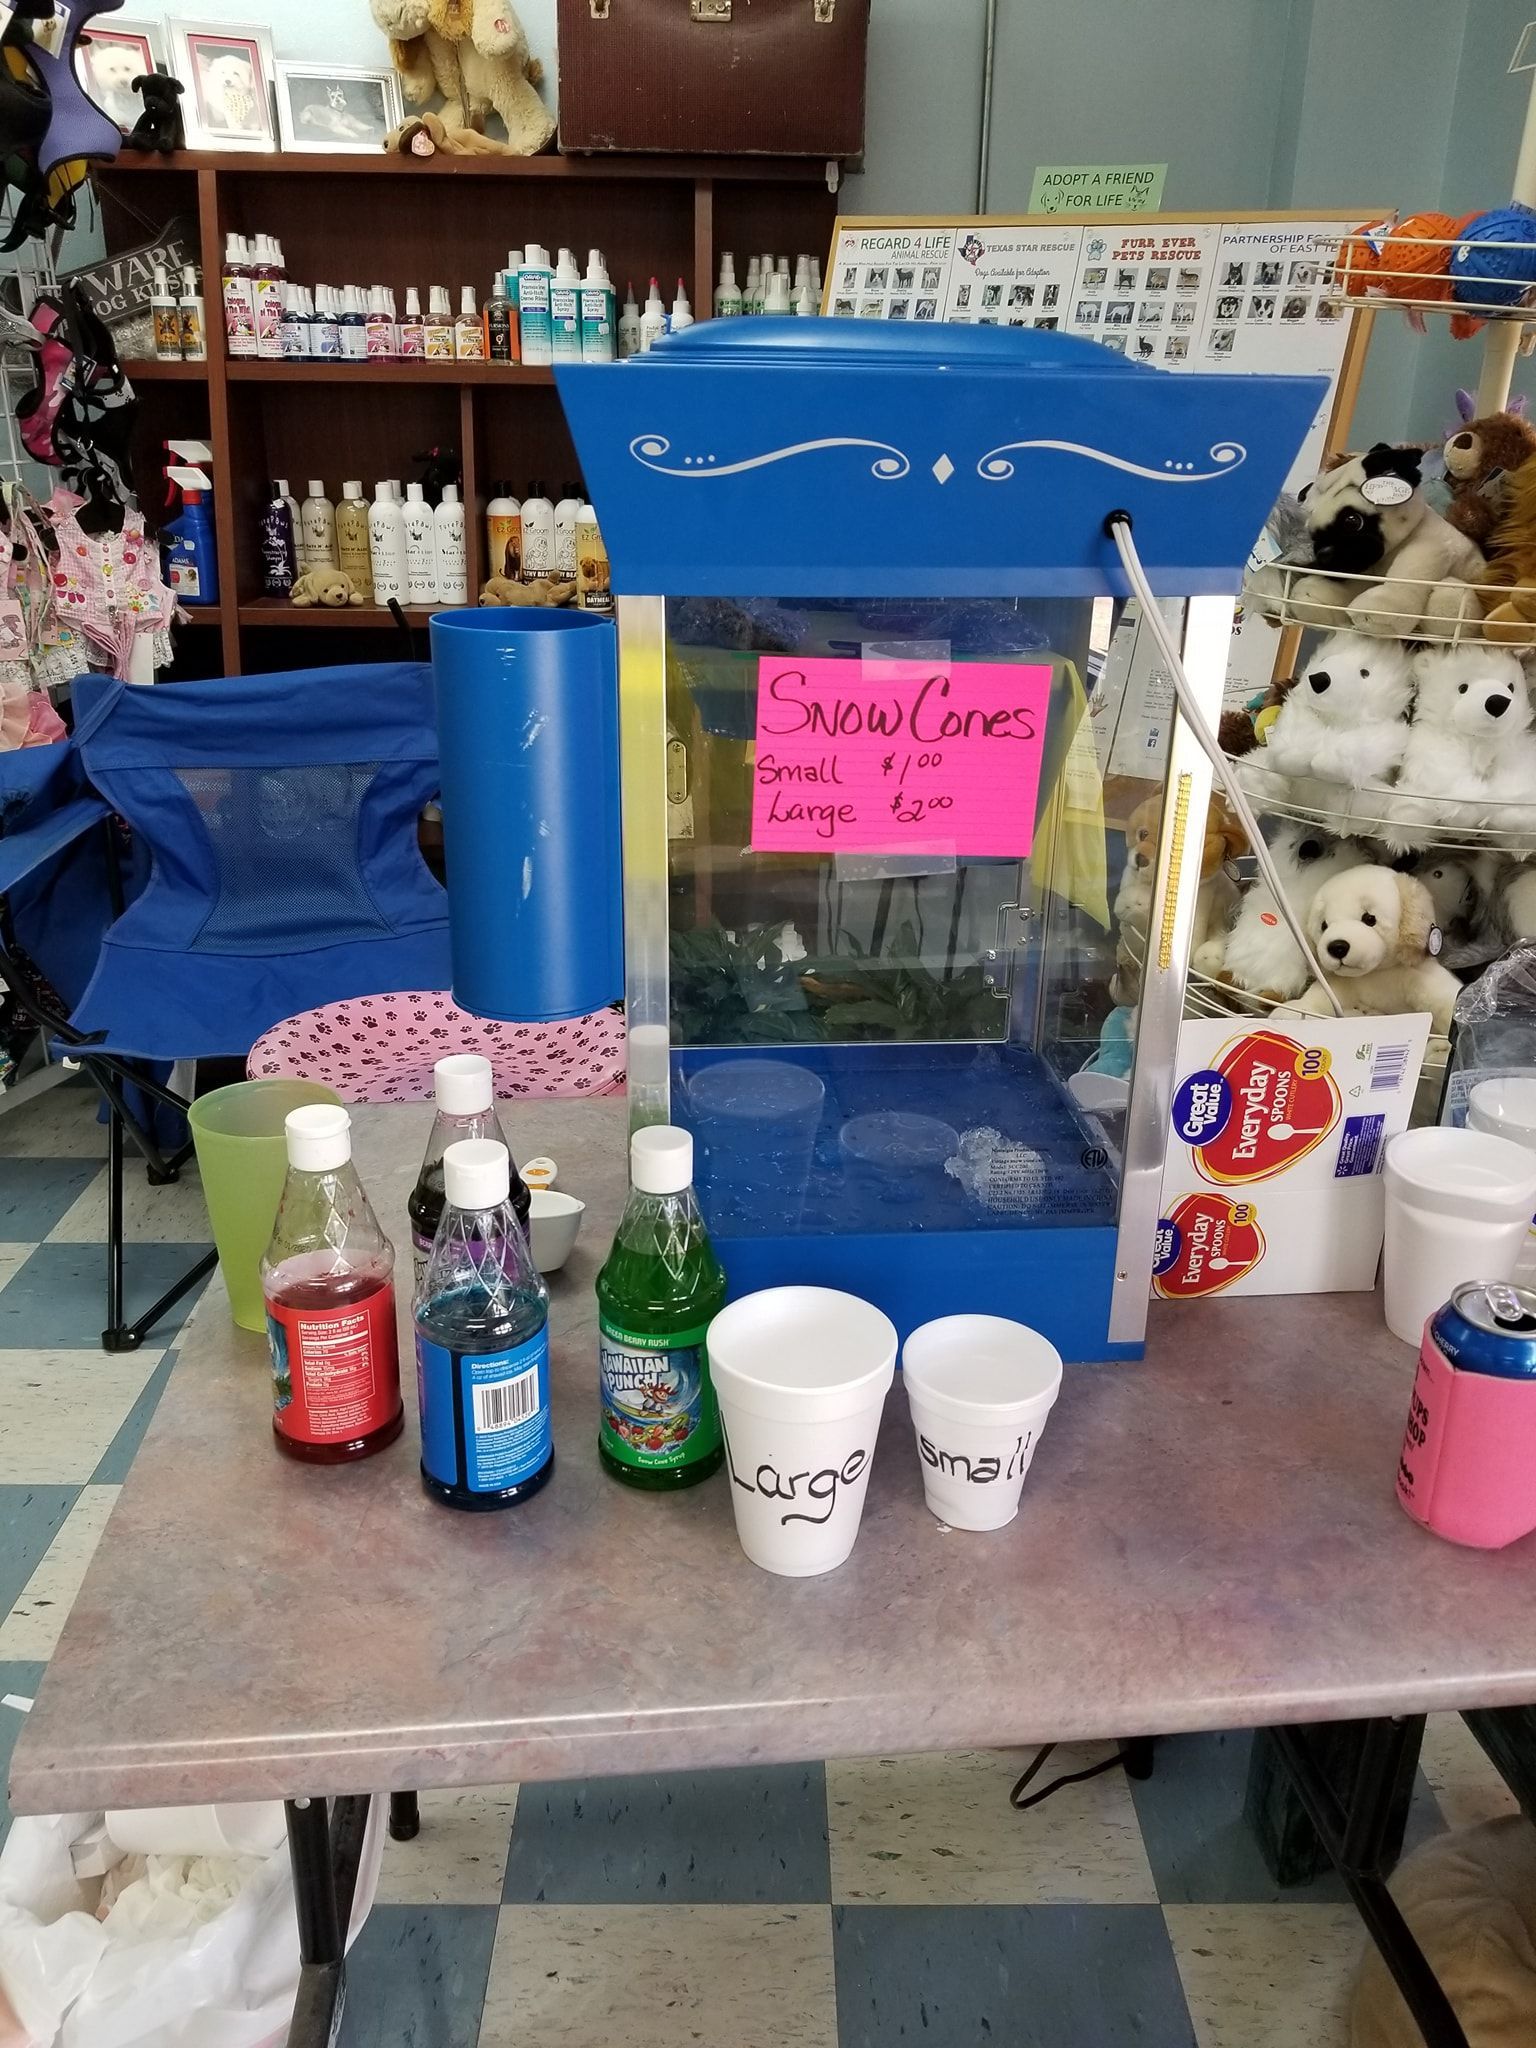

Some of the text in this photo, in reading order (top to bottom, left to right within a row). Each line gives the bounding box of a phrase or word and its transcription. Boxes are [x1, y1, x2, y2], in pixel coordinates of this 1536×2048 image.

[1043, 172, 1154, 186] ADOPT A FRIEND
[1066, 194, 1123, 206] FOR LIFE
[861, 236, 951, 250] REGARD 4 LIFE
[1016, 244, 1038, 252] STAR
[1040, 244, 1075, 252] RESCUE
[1121, 237, 1196, 248] FURR EVER
[1222, 234, 1304, 245] PARTNERSHIP
[1270, 244, 1284, 254] OF
[1289, 244, 1318, 253] EAST
[891, 249, 949, 260] ANIMAL RESCUE
[1112, 250, 1201, 260] PETS RESCUE
[79, 239, 194, 297] WARE
[93, 294, 128, 317] OG
[757, 754, 843, 786] Small
[768, 790, 857, 838] Large
[1302, 1049, 1322, 1076] 100
[1204, 1084, 1222, 1125] Value
[1270, 1070, 1292, 1122] SPOONS
[1183, 1083, 1210, 1137] Great
[1232, 1061, 1277, 1160] Everyday
[1234, 1204, 1249, 1224] 100
[1160, 1228, 1174, 1260] Value
[1182, 1212, 1214, 1284] Everyday
[1210, 1220, 1226, 1256] SPOONS
[300, 1315, 364, 1330] Nutrition Facts
[624, 1335, 646, 1346] BERRY
[648, 1338, 668, 1346] RUSH
[1435, 1330, 1460, 1356] CHERRY
[472, 1359, 510, 1370] Directions:
[601, 1350, 671, 1374] HAWAIIAN
[607, 1373, 658, 1392] PUNCH
[638, 1456, 653, 1464] Snow
[669, 1452, 686, 1464] Syrup
[720, 1410, 872, 1526] Large
